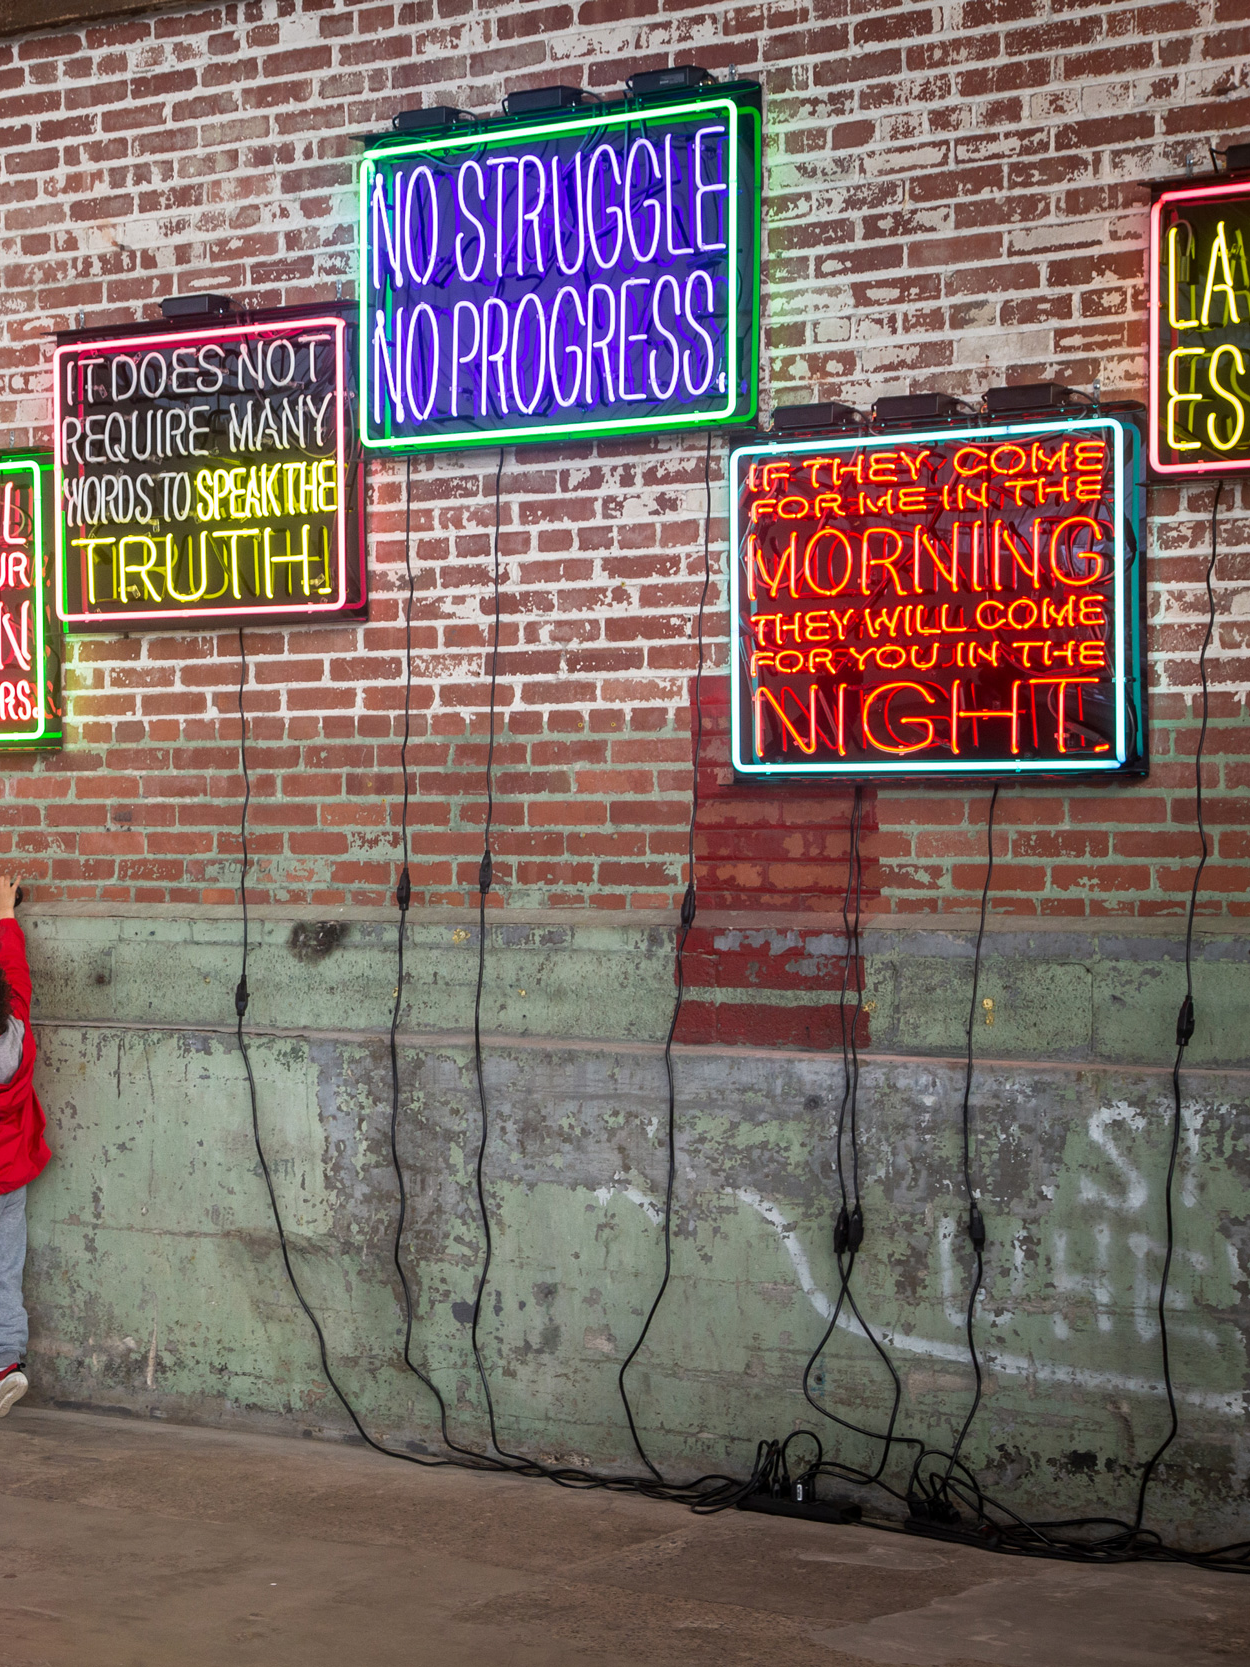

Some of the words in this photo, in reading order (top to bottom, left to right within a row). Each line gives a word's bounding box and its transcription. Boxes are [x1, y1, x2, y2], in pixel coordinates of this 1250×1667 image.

[373, 166, 438, 289] NO
[455, 126, 726, 282] STRUGGLE
[67, 358, 104, 406] IT
[112, 344, 225, 402] DOES
[238, 334, 331, 391] NOT
[373, 302, 440, 424] NO
[452, 270, 727, 417] PROGRESS.
[62, 405, 210, 465] REQUIRE
[229, 393, 332, 453] MANY
[63, 473, 154, 527] WORDS
[159, 471, 191, 522] TO
[196, 462, 282, 522] SPEAK
[282, 460, 338, 513] THE
[749, 462, 791, 492] IF
[803, 450, 931, 488] THEY
[953, 442, 1107, 476] COME
[750, 494, 845, 524] FOR
[859, 487, 927, 516] ME
[943, 482, 988, 510] IN
[1004, 475, 1102, 506] THE
[748, 517, 1103, 600] MORNING
[750, 609, 853, 646] THEY
[865, 604, 967, 638] WILL
[976, 596, 1106, 630] COME
[750, 648, 836, 678] FOR
[850, 642, 939, 671] YOU
[956, 641, 1000, 667] IN
[1012, 641, 1107, 668] THE
[756, 678, 1110, 757] NIGHT.
